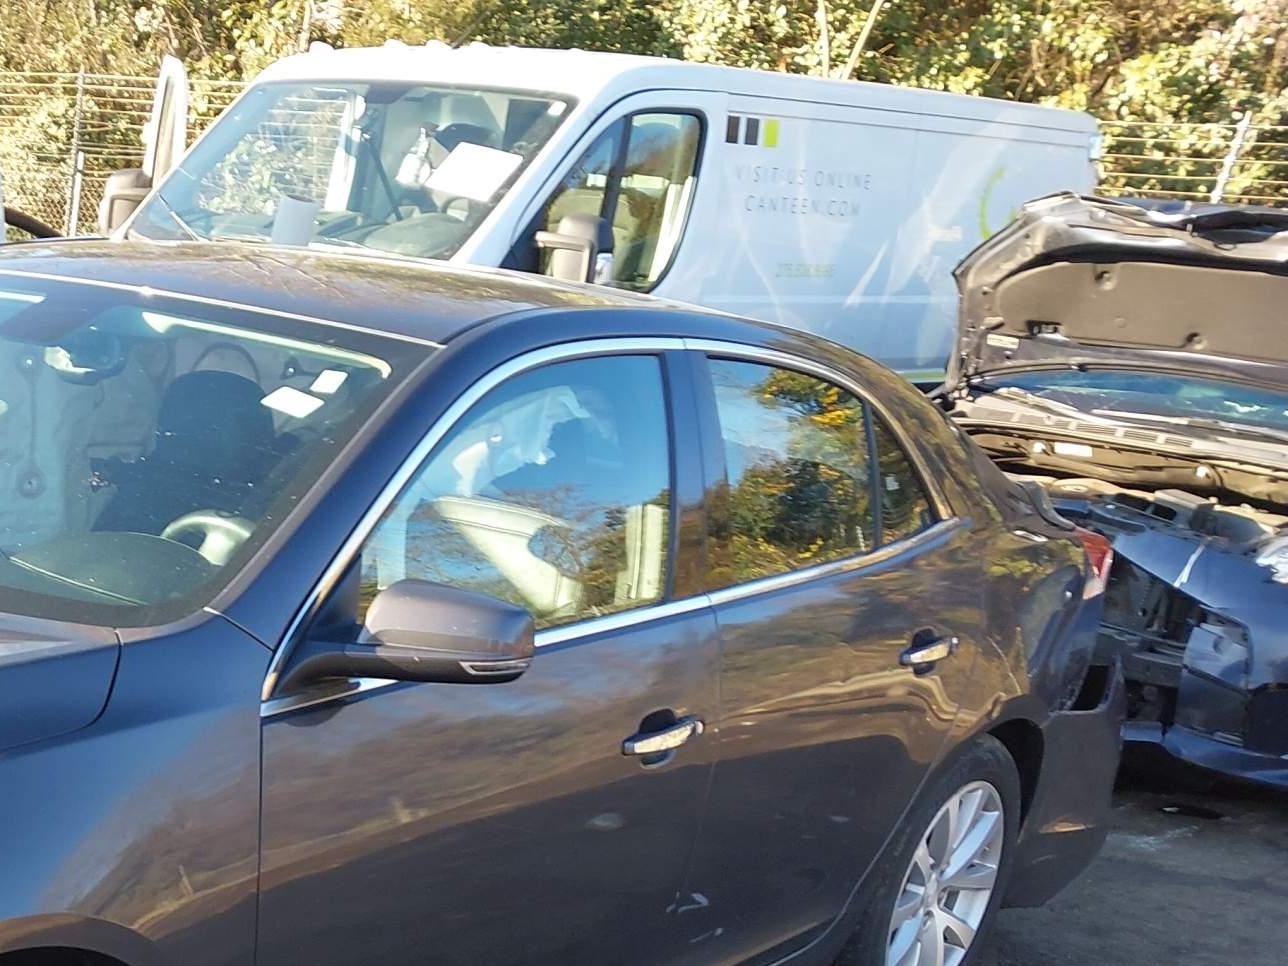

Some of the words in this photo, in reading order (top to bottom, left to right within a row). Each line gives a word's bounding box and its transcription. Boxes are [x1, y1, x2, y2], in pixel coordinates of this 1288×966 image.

[736, 165, 779, 183] VISIT
[786, 168, 807, 185] US
[814, 170, 872, 191] ONLINE
